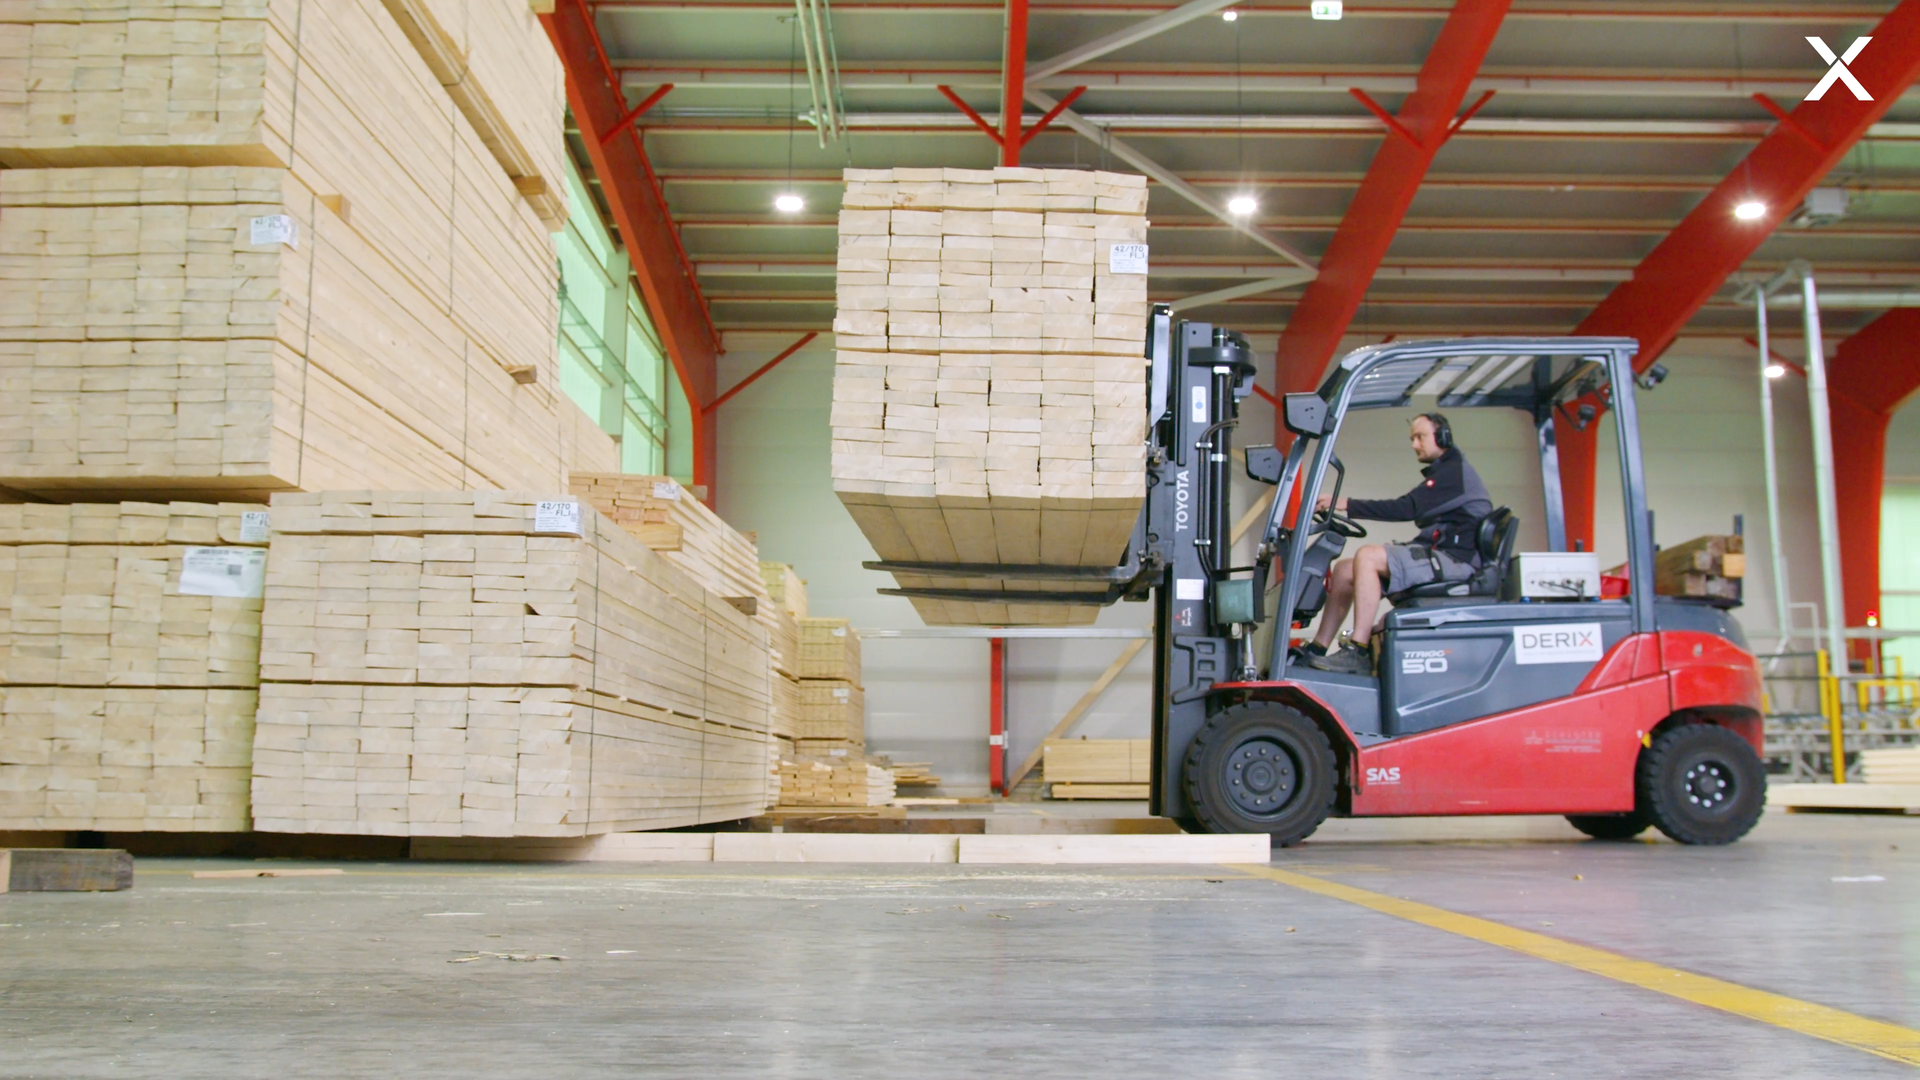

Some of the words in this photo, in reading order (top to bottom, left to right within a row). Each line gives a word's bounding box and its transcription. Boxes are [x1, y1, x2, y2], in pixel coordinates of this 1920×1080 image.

[541, 502, 571, 510] 42/170
[1176, 470, 1189, 532] TOYOTA
[1522, 631, 1594, 649] DERIX
[1402, 658, 1448, 674] 50
[1366, 767, 1401, 781] SAS
